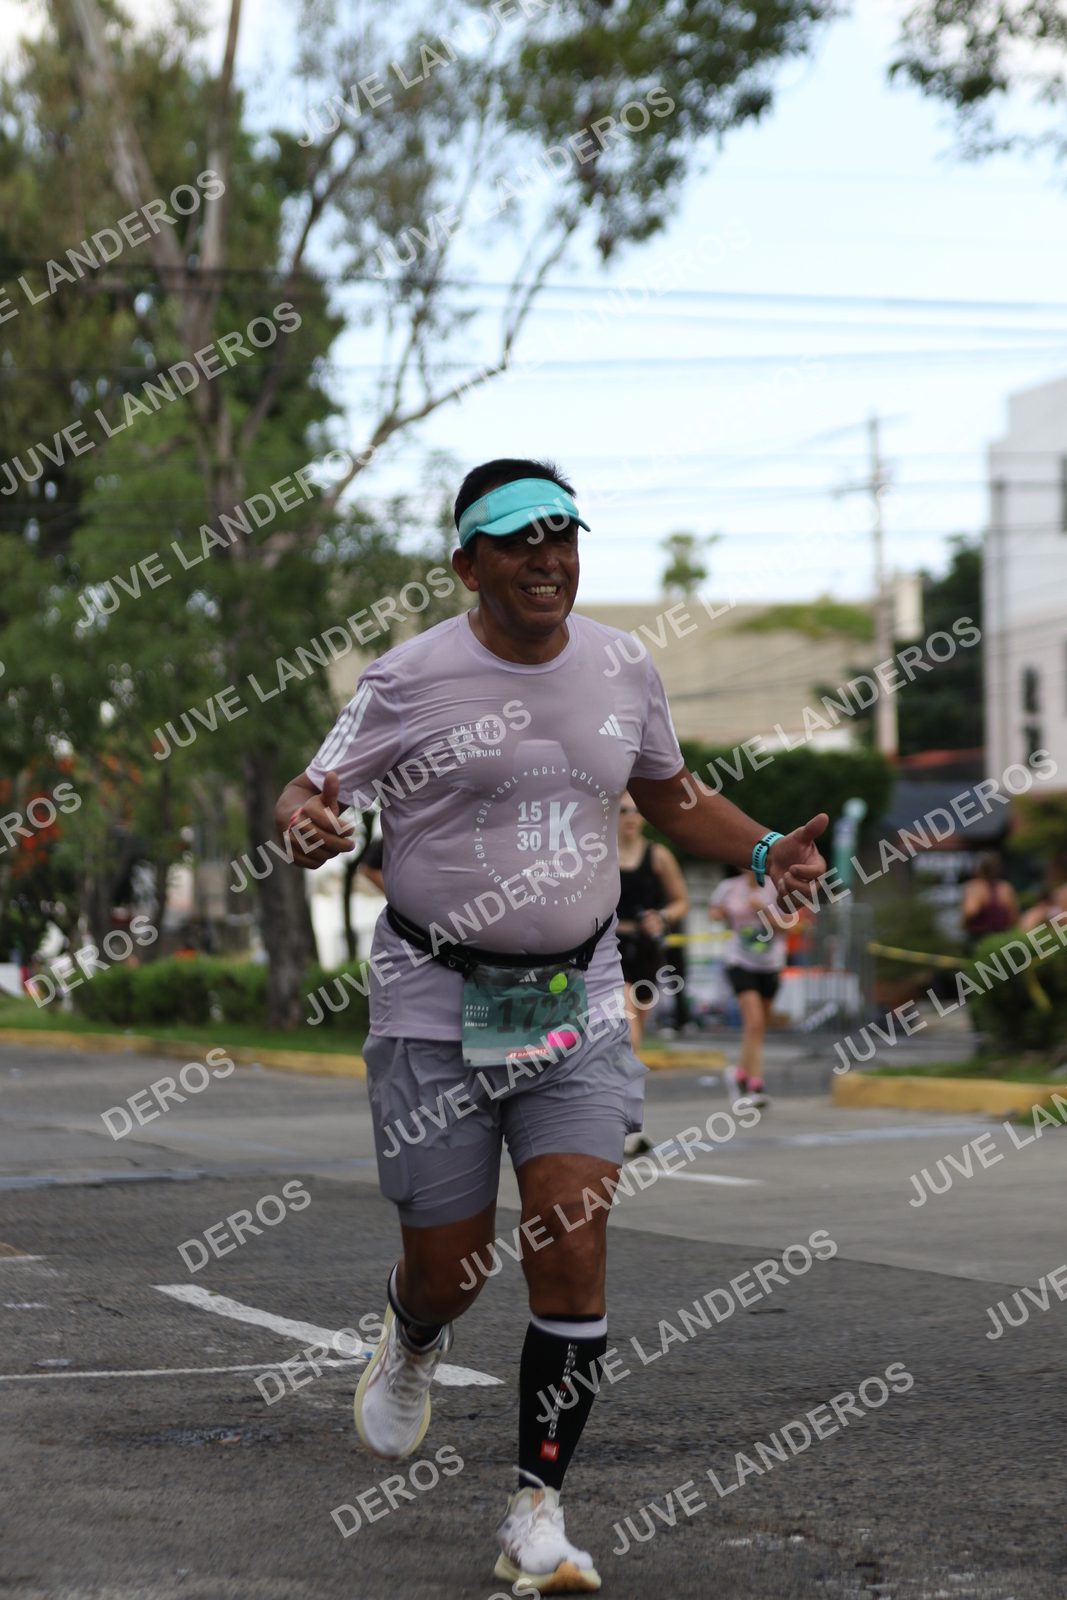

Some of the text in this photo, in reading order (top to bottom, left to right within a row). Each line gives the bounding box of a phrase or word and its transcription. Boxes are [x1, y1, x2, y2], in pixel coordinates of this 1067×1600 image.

[452, 720, 498, 735] ADIDAS
[532, 766, 556, 776] GDL
[571, 769, 593, 785] GDL
[496, 776, 518, 794] GDL
[476, 801, 492, 824] GDL
[517, 801, 542, 821] 15
[549, 802, 578, 852] K
[517, 831, 542, 851] 30
